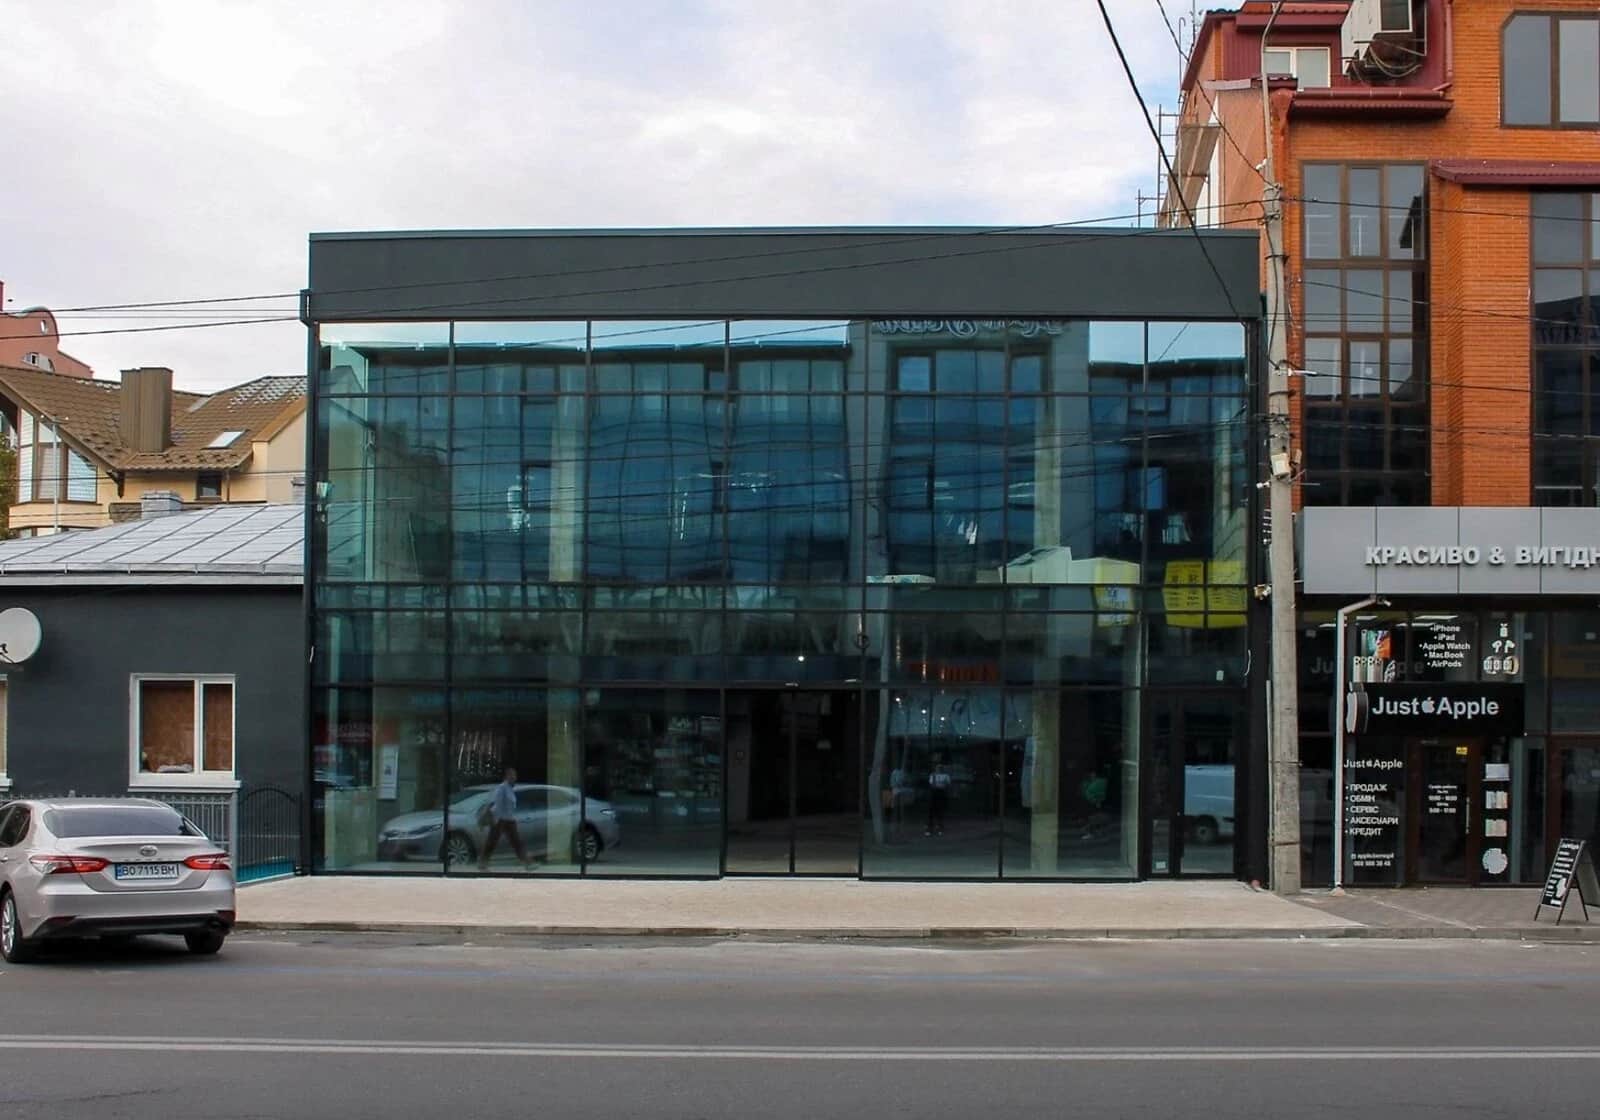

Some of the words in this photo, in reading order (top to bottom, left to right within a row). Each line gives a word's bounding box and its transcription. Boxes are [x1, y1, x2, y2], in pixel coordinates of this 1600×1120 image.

[1365, 547, 1481, 566] КРАСИВО
[1488, 547, 1506, 566] &
[1433, 624, 1460, 632] iPhone
[1438, 633, 1456, 641] iPad
[1423, 642, 1445, 651] Apple
[1446, 642, 1471, 650] Watch
[1429, 651, 1464, 659] MacBook
[1432, 660, 1462, 668] AirPods
[1372, 697, 1420, 715] Just
[1436, 697, 1500, 719] Apple
[1344, 759, 1366, 769] Just
[1373, 759, 1403, 770] Apple
[1350, 784, 1387, 792] ПРОДАЖ
[1350, 816, 1399, 825] АКСЕСУАРИ
[1349, 827, 1382, 836] КРЕДИТ
